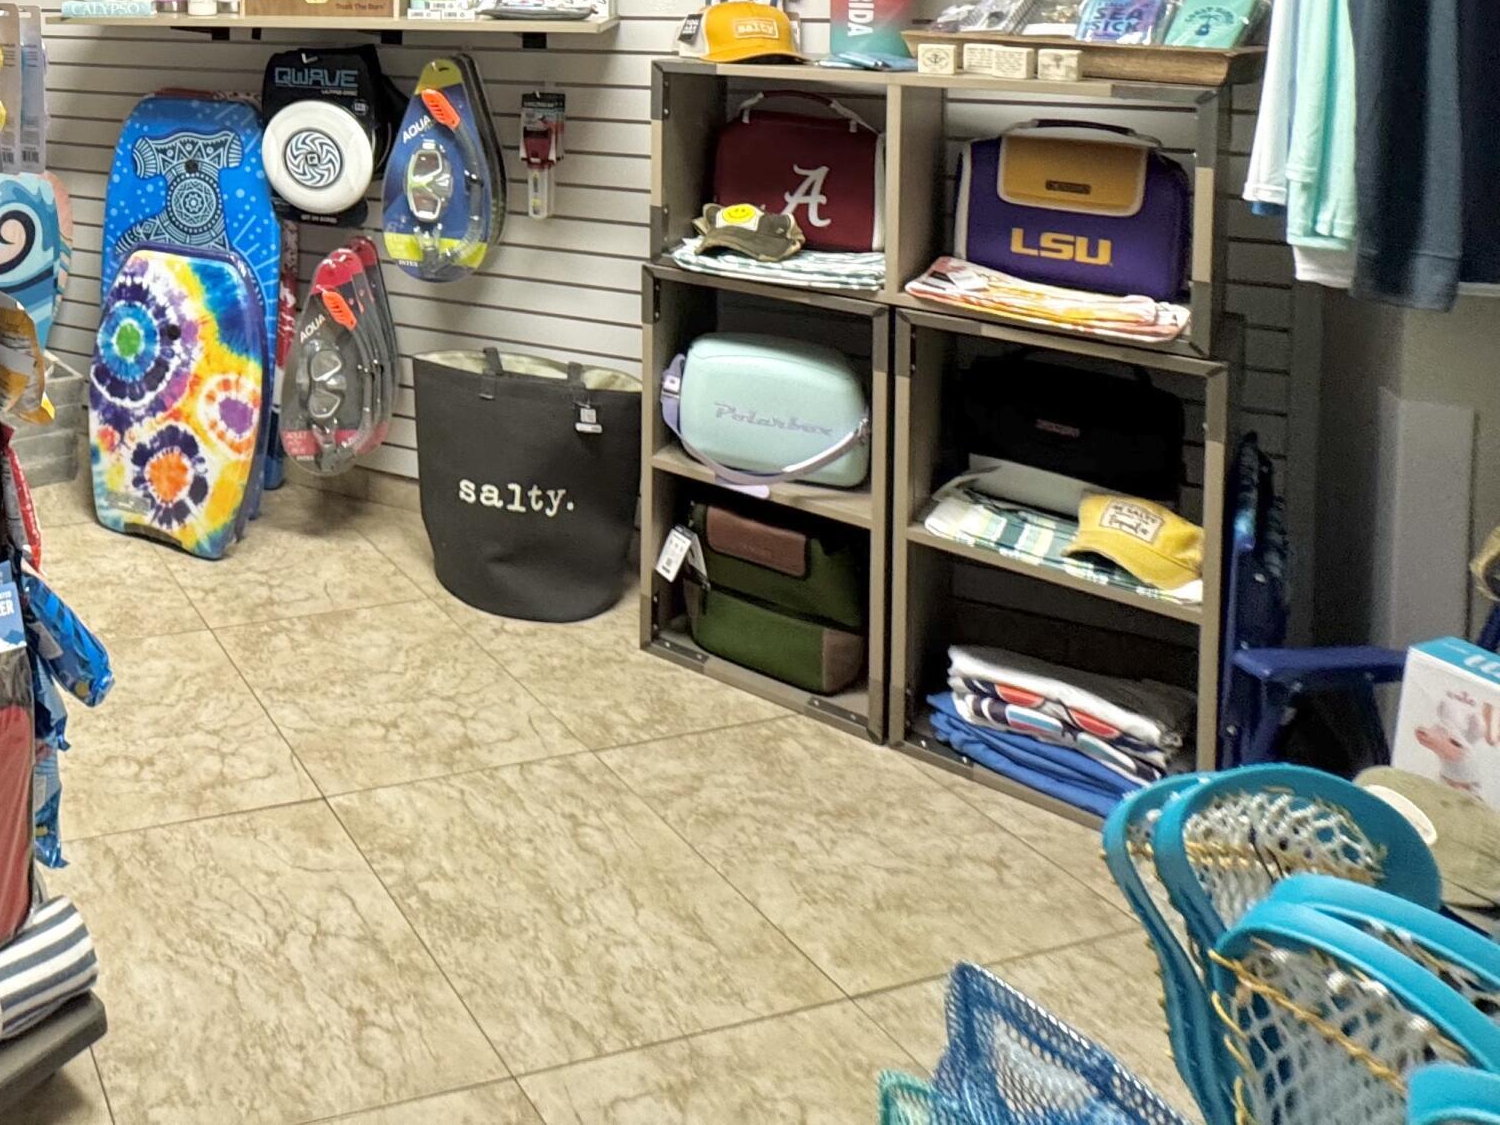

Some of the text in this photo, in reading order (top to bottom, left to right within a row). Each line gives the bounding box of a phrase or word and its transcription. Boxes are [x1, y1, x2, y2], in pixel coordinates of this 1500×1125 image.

[71, 2, 140, 16] CALYPSO
[1094, 6, 1143, 21] SEA
[274, 66, 359, 87] QWAVE
[403, 115, 432, 144] AQUA
[1010, 227, 1112, 266] LSU
[300, 314, 326, 345] AQUA
[714, 401, 834, 438] Polarbox
[459, 478, 575, 518] salty.
